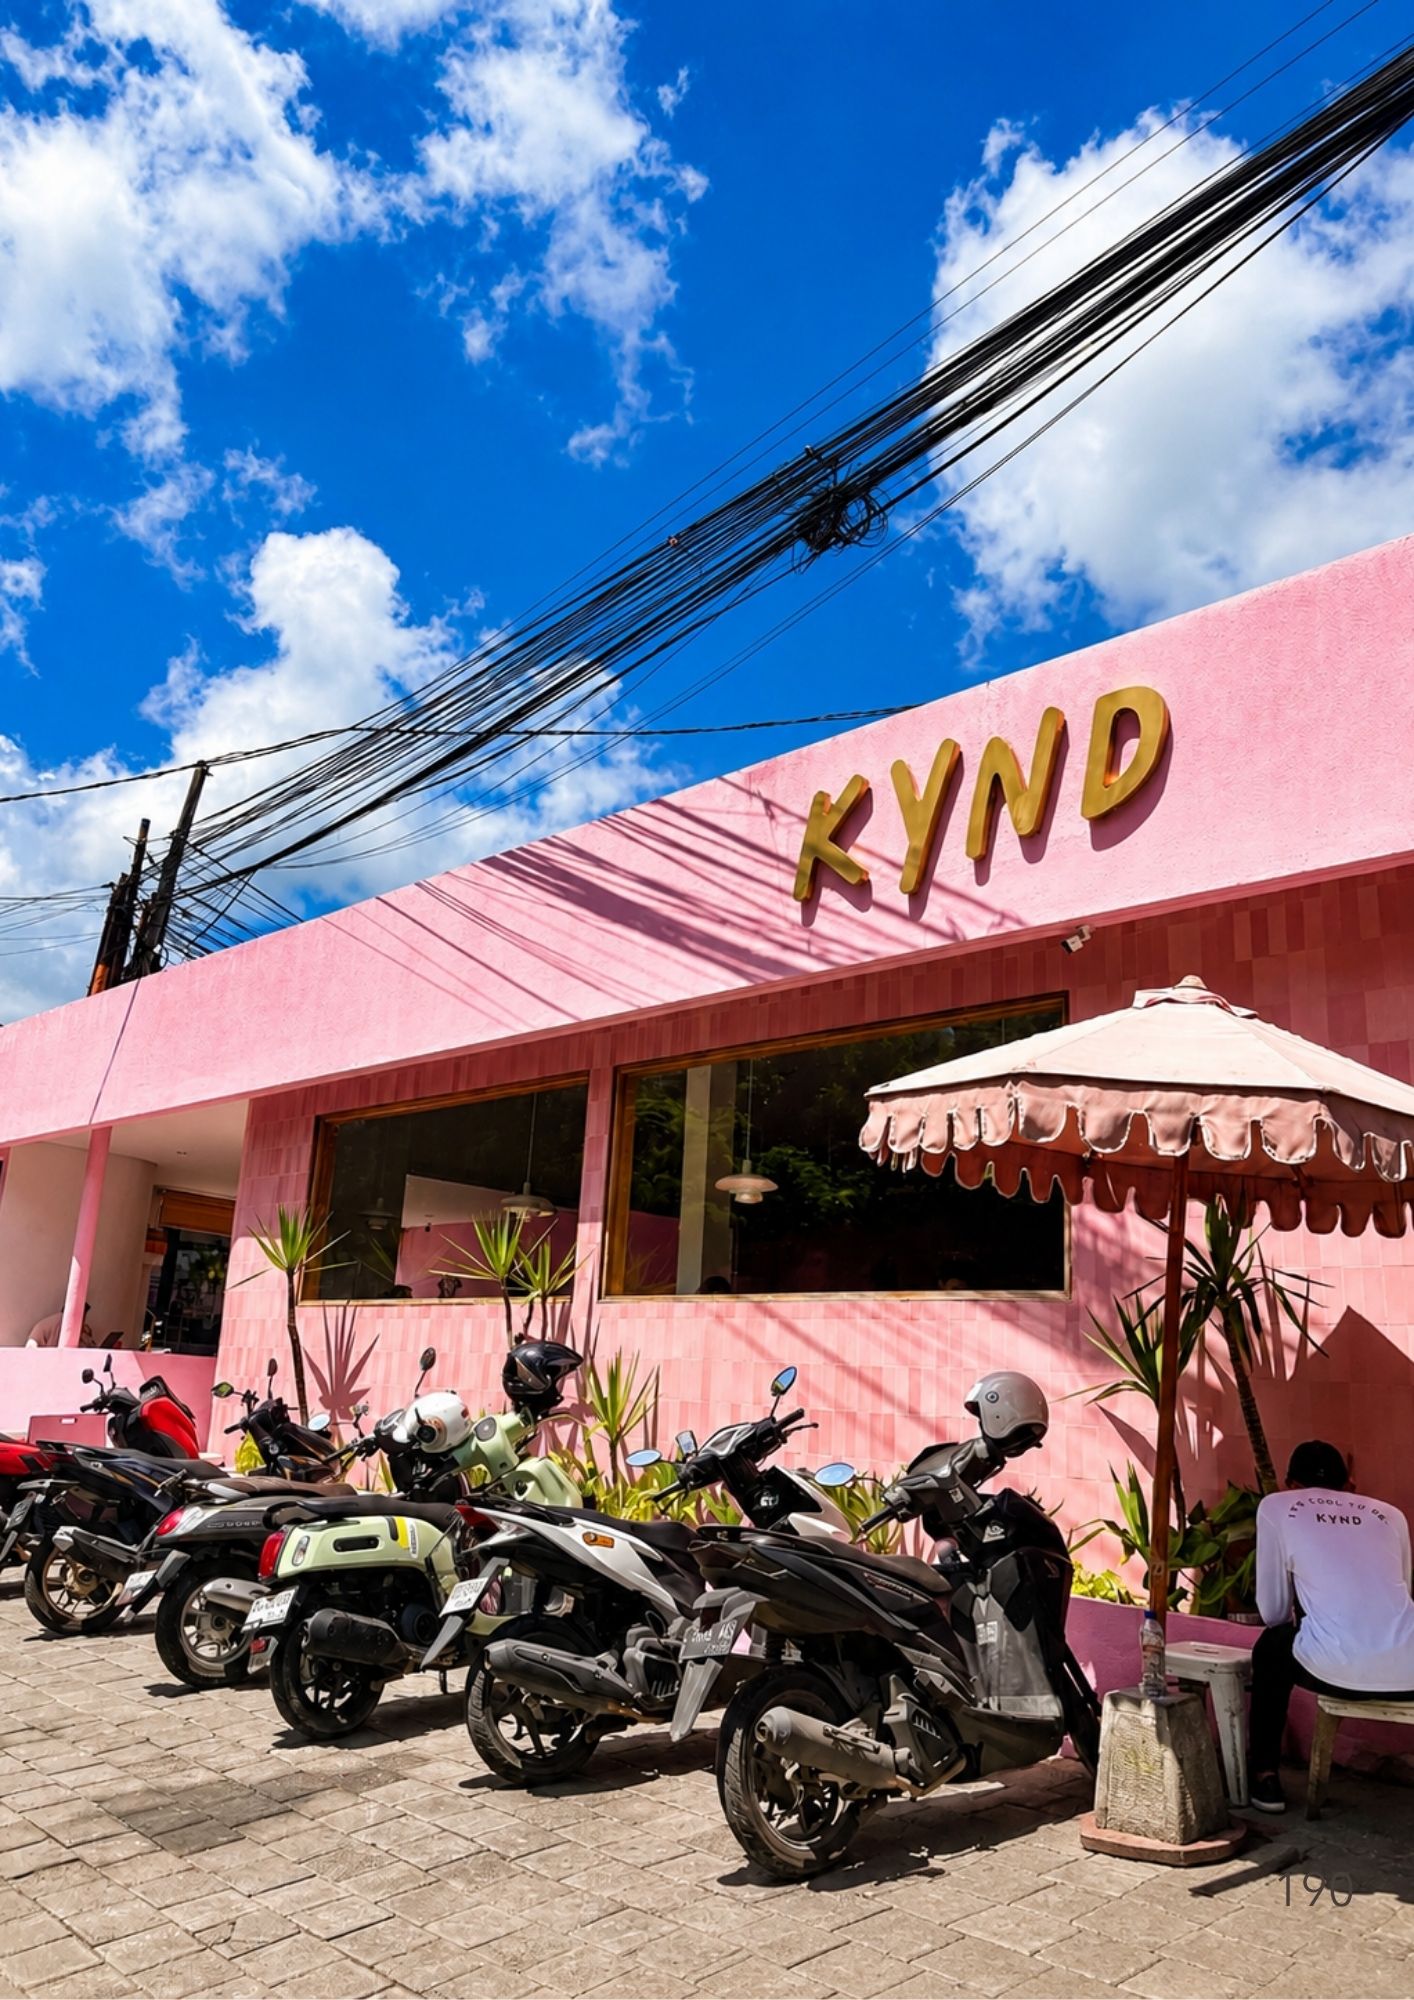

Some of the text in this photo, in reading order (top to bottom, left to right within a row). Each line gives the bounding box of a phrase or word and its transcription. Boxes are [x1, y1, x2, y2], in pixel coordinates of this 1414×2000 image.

[792, 686, 1170, 903] KYND
[1308, 1497, 1343, 1507] COOL
[1316, 1513, 1362, 1526] KYND
